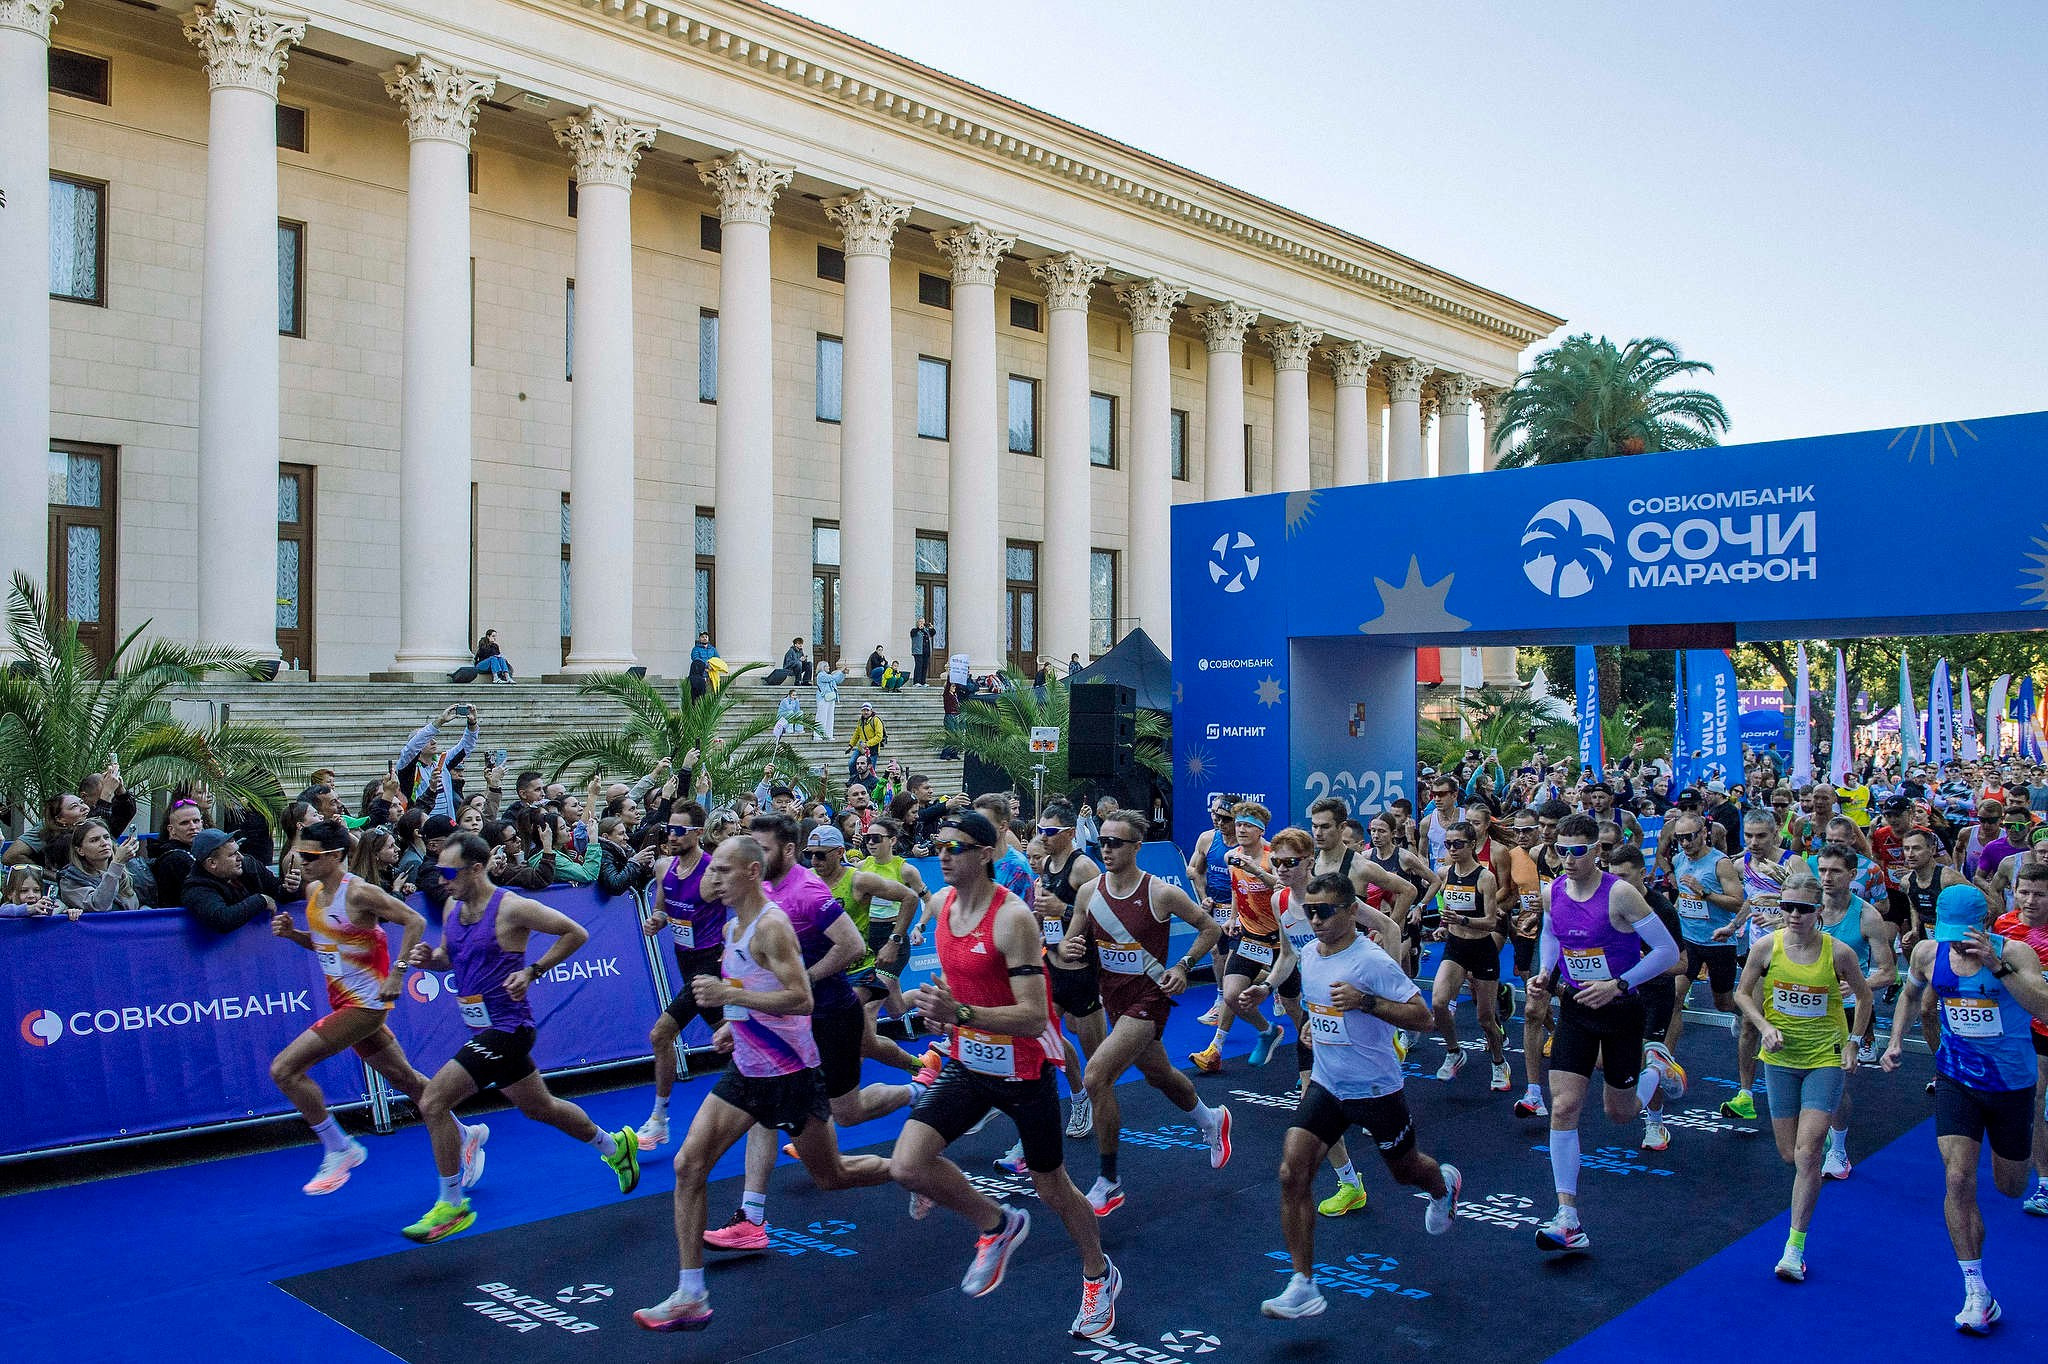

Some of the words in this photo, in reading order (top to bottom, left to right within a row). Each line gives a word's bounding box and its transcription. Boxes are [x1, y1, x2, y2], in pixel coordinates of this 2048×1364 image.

[1628, 485, 1816, 515] СОВКОМБАНК
[1627, 510, 1817, 563] СОЧИ
[1628, 557, 1817, 588] МАРАФОН
[1209, 658, 1274, 669] СОВКОМБАНК
[1222, 726, 1267, 737] МАГНИТ
[1446, 891, 1471, 902] 3545
[1682, 899, 1703, 910] 3519
[1102, 949, 1137, 963] 3700
[1242, 942, 1270, 957] 3864
[1567, 957, 1602, 969] 3078
[1778, 990, 1822, 1006] 3865
[69, 990, 311, 1036] СОВКОМБАНК
[1949, 1007, 1994, 1022] 3358
[963, 1040, 1006, 1061] 3932
[476, 1281, 600, 1335] ВЫСШАЯ
[462, 1300, 542, 1334] ЛИГА
